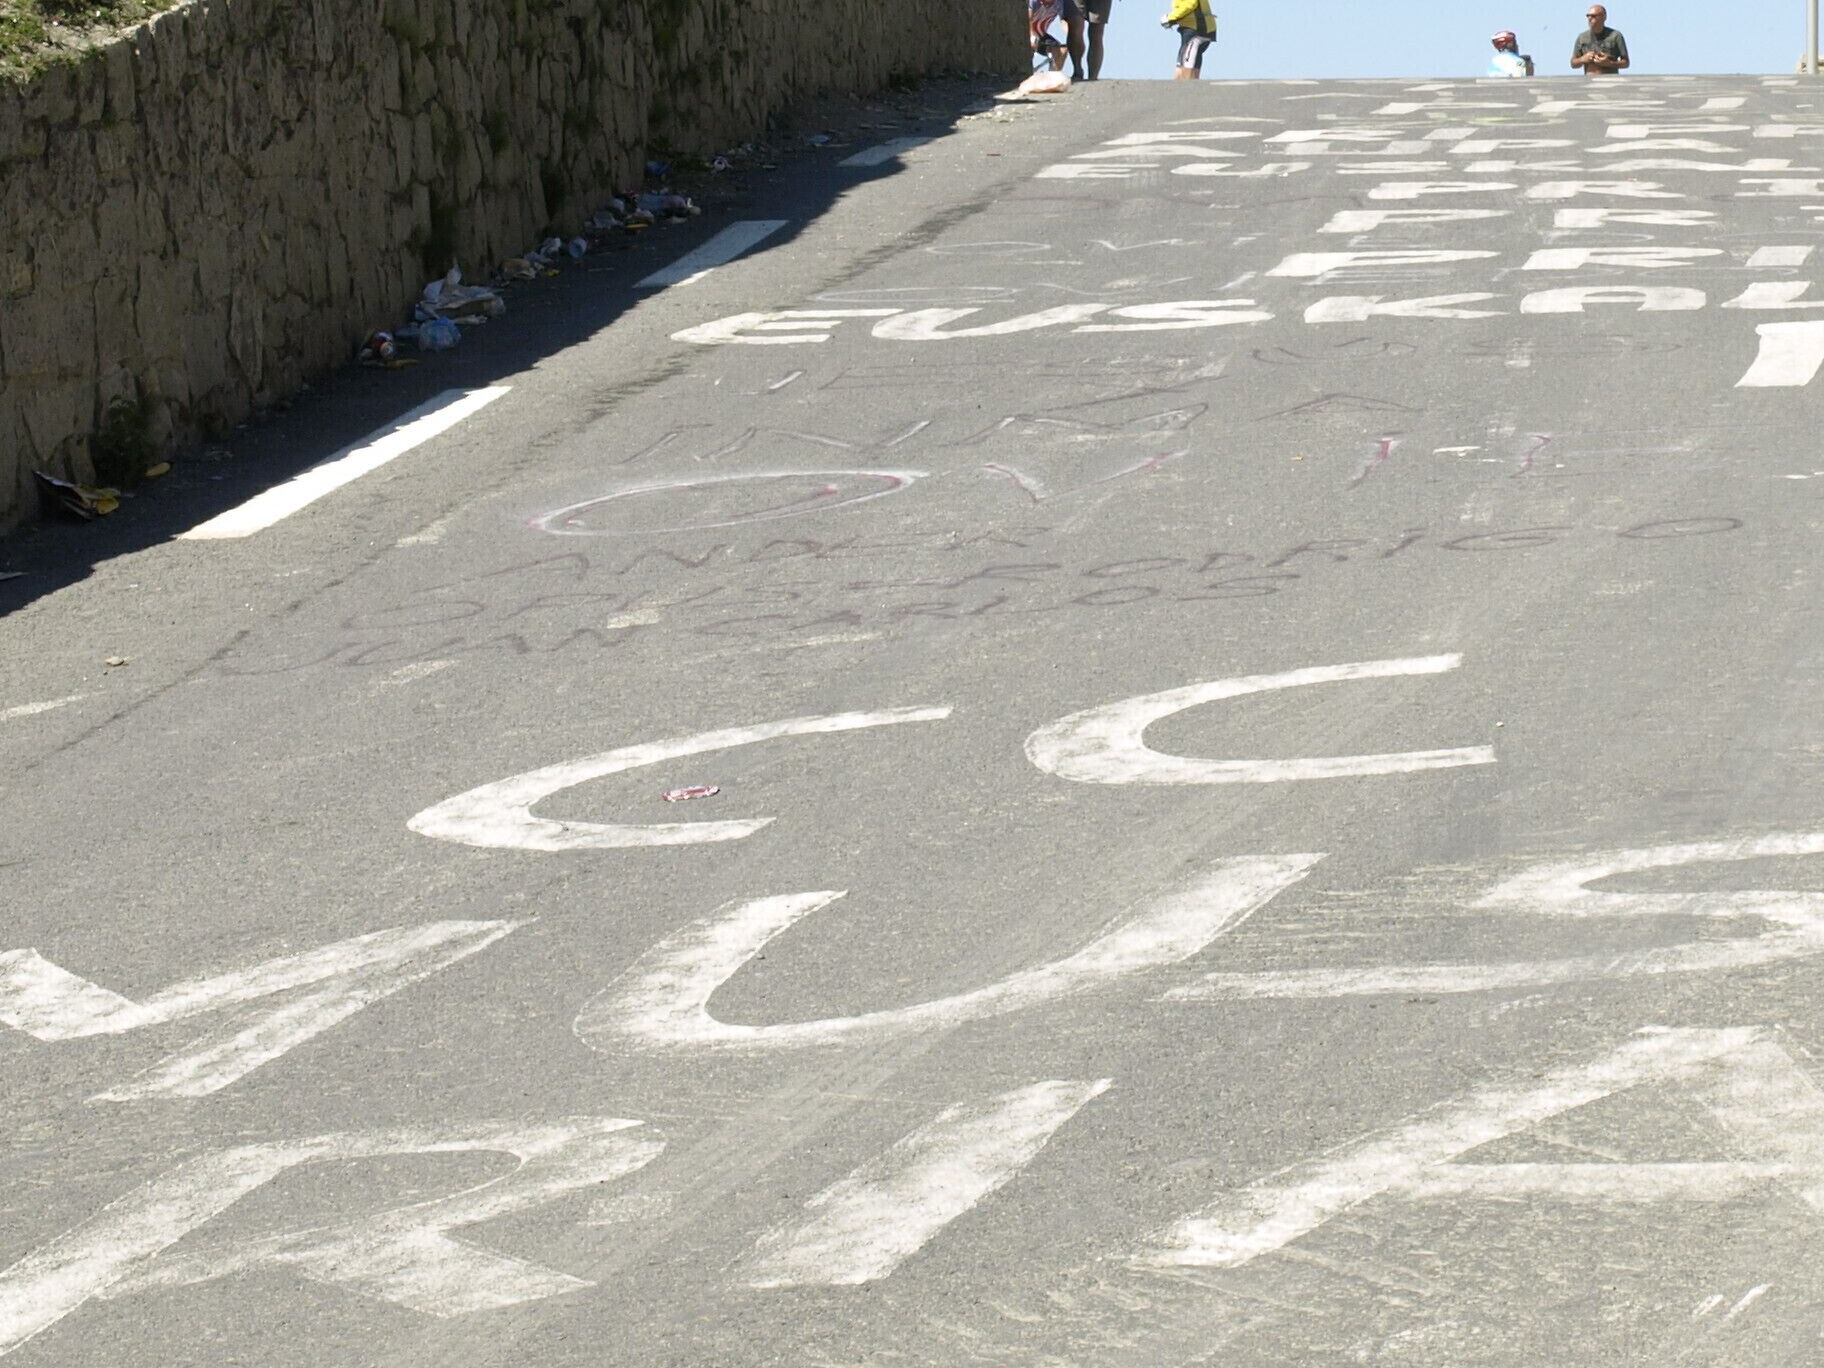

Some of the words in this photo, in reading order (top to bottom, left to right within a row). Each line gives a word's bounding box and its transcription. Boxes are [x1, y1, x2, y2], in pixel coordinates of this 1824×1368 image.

[1368, 97, 1748, 115] PRI
[1100, 128, 1478, 146] PRI
[1066, 138, 1745, 160] AUPA
[1263, 245, 1820, 277] PRI
